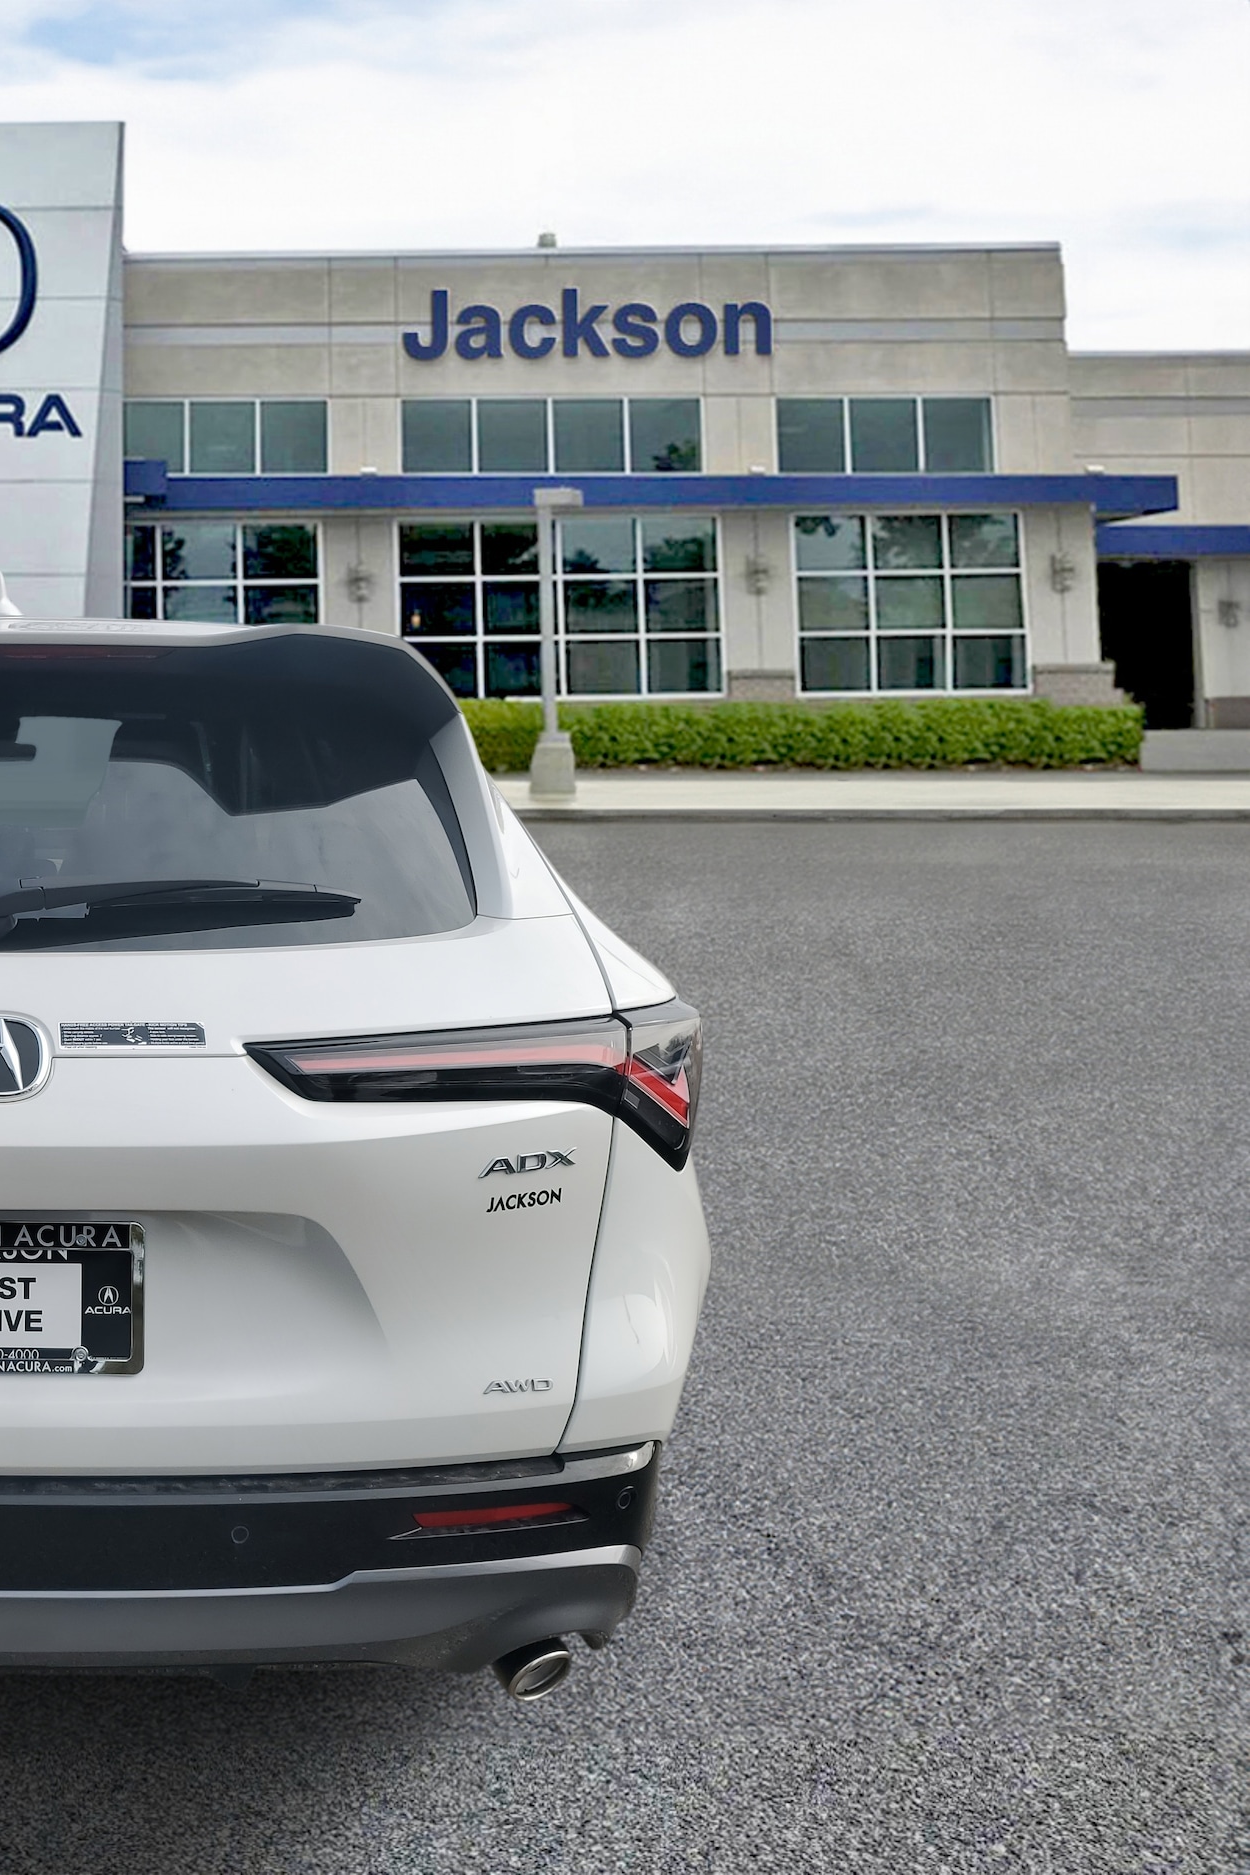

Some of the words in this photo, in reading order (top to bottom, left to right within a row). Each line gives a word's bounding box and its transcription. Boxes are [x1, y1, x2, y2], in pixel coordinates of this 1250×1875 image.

[403, 288, 773, 361] Jackson
[478, 1146, 577, 1179] ADX
[486, 1187, 562, 1213] JACKSON
[13, 1223, 123, 1248] ACURA
[84, 1305, 132, 1315] ACURA
[483, 1377, 554, 1395] AWD
